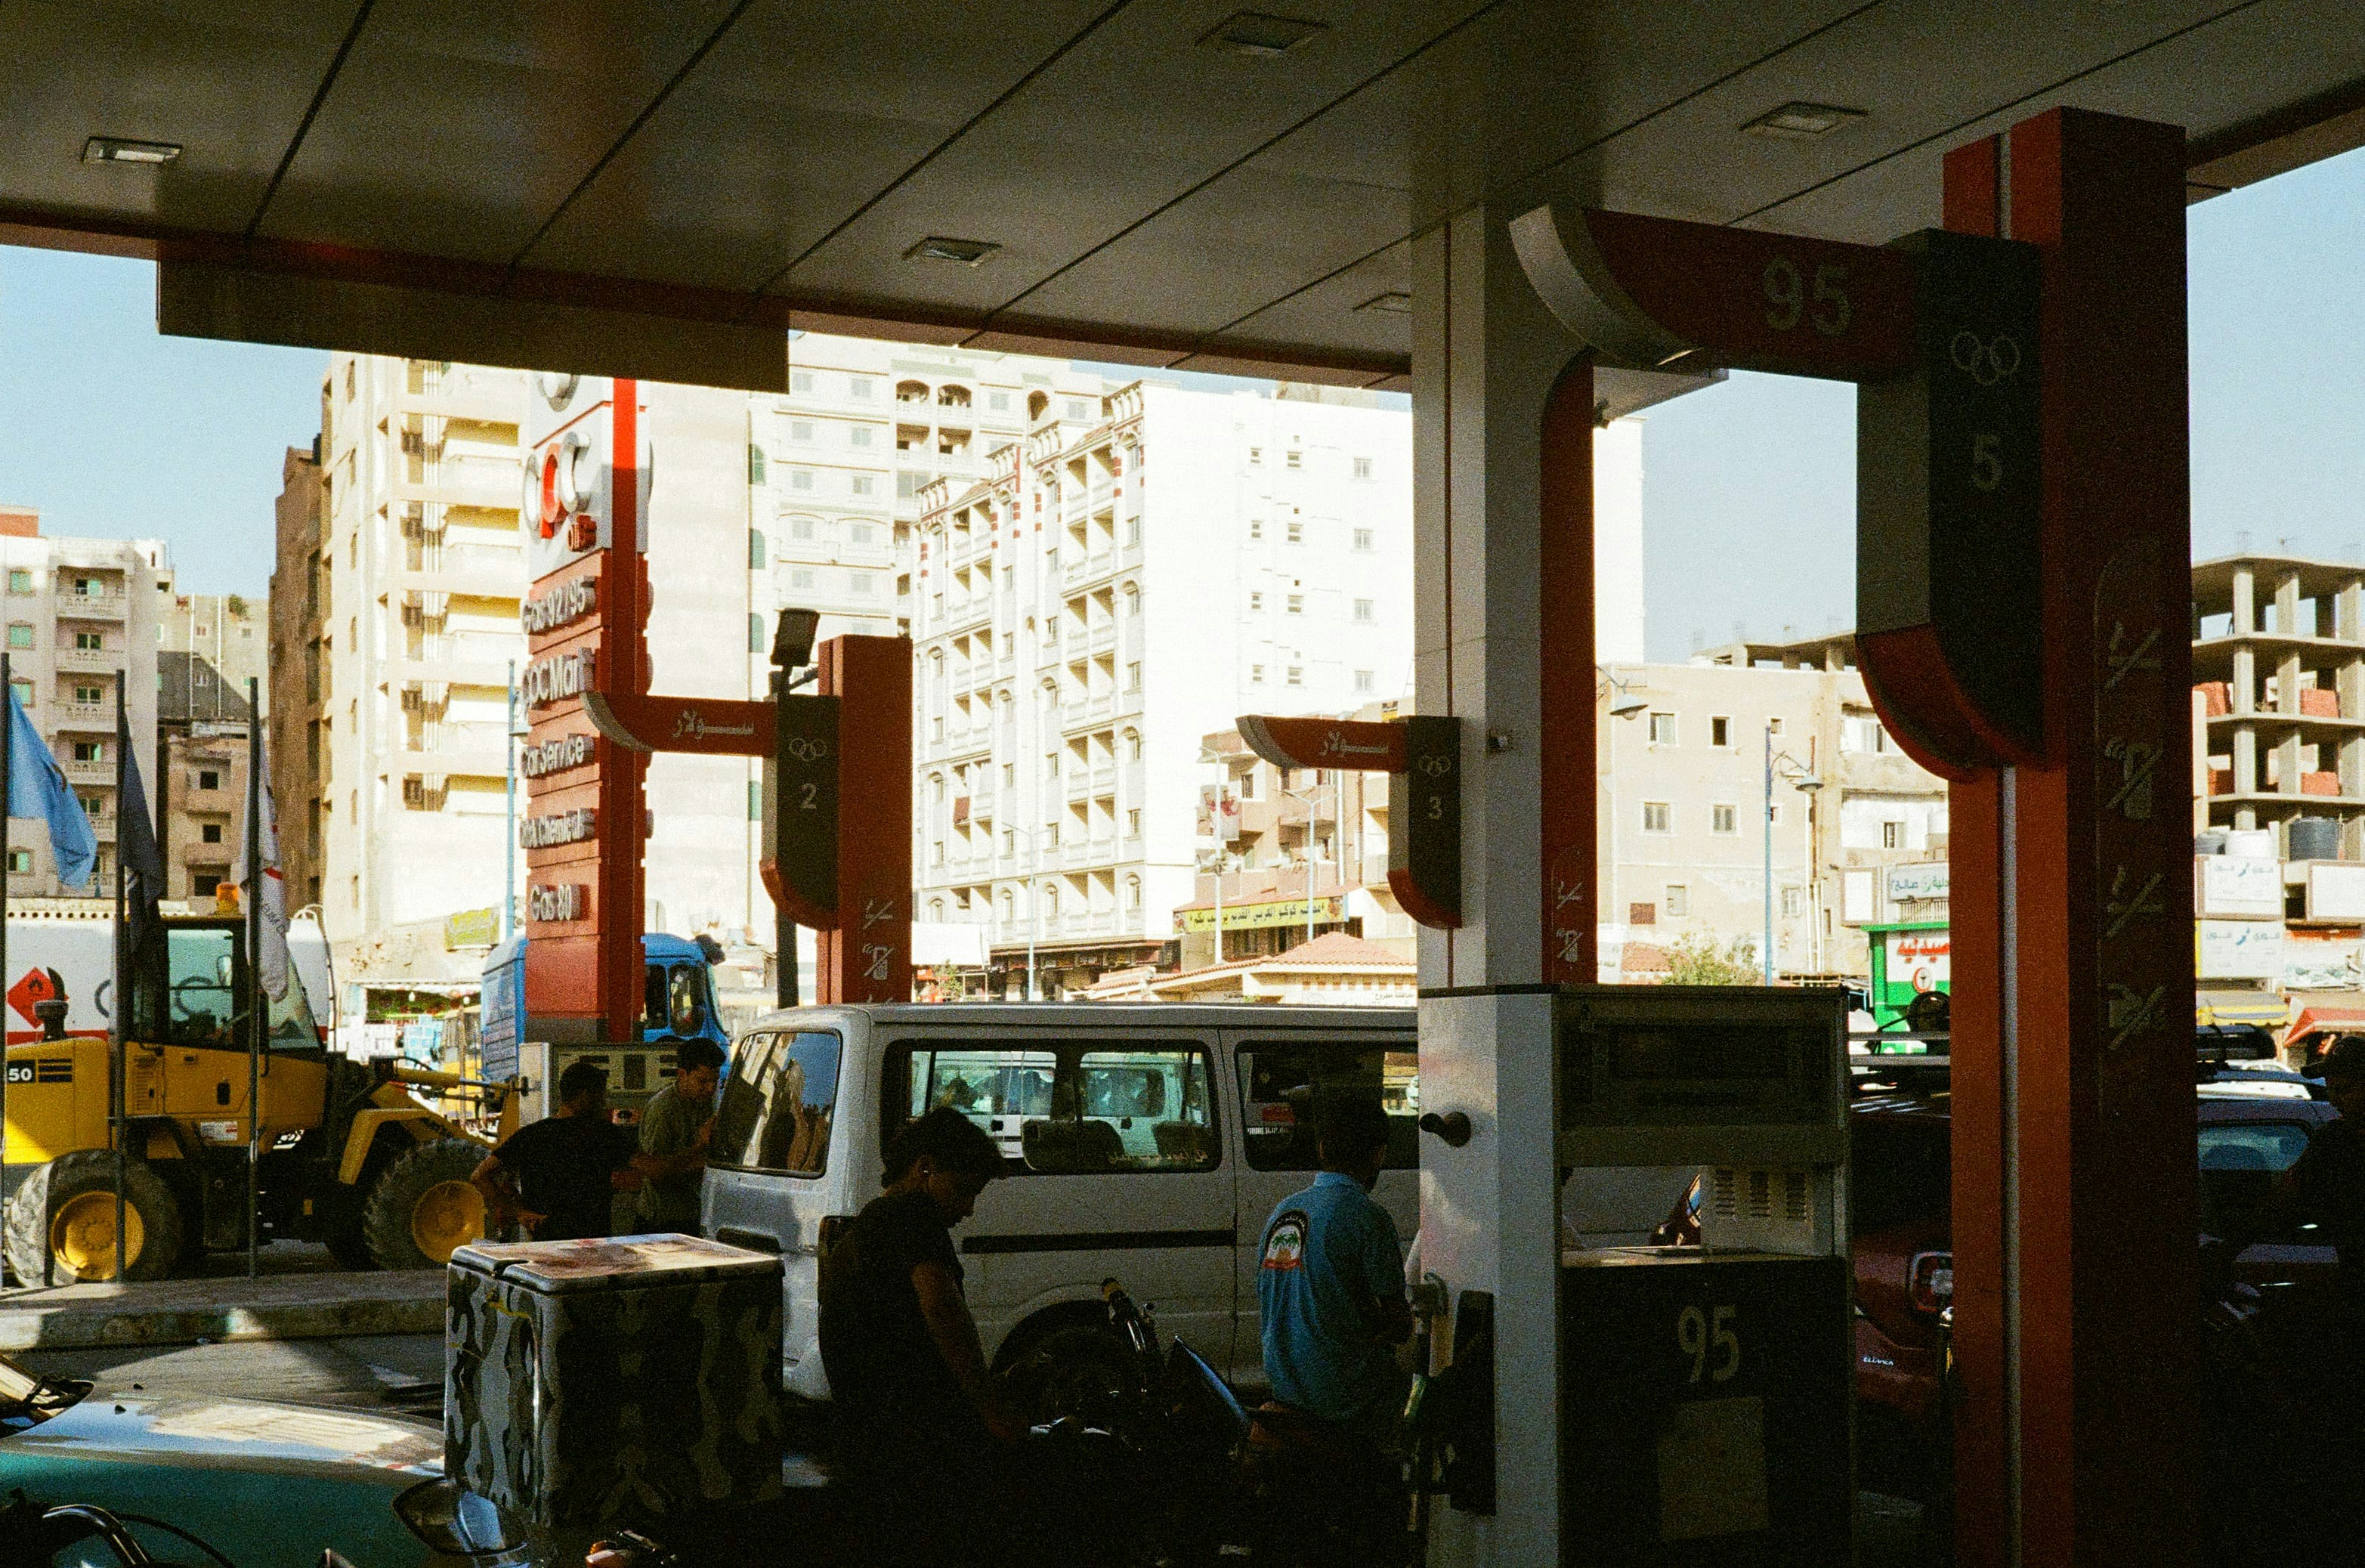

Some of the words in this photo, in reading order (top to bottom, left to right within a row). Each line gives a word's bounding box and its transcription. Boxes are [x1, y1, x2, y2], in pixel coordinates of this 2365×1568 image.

[1764, 256, 1853, 338] 95
[1972, 434, 2002, 490] 5
[800, 783, 818, 809] 2
[1429, 796, 1442, 820] 3
[531, 885, 556, 921] Gas
[558, 882, 576, 921] 80
[8, 1068, 32, 1081] 50
[1678, 1305, 1739, 1383] 95
